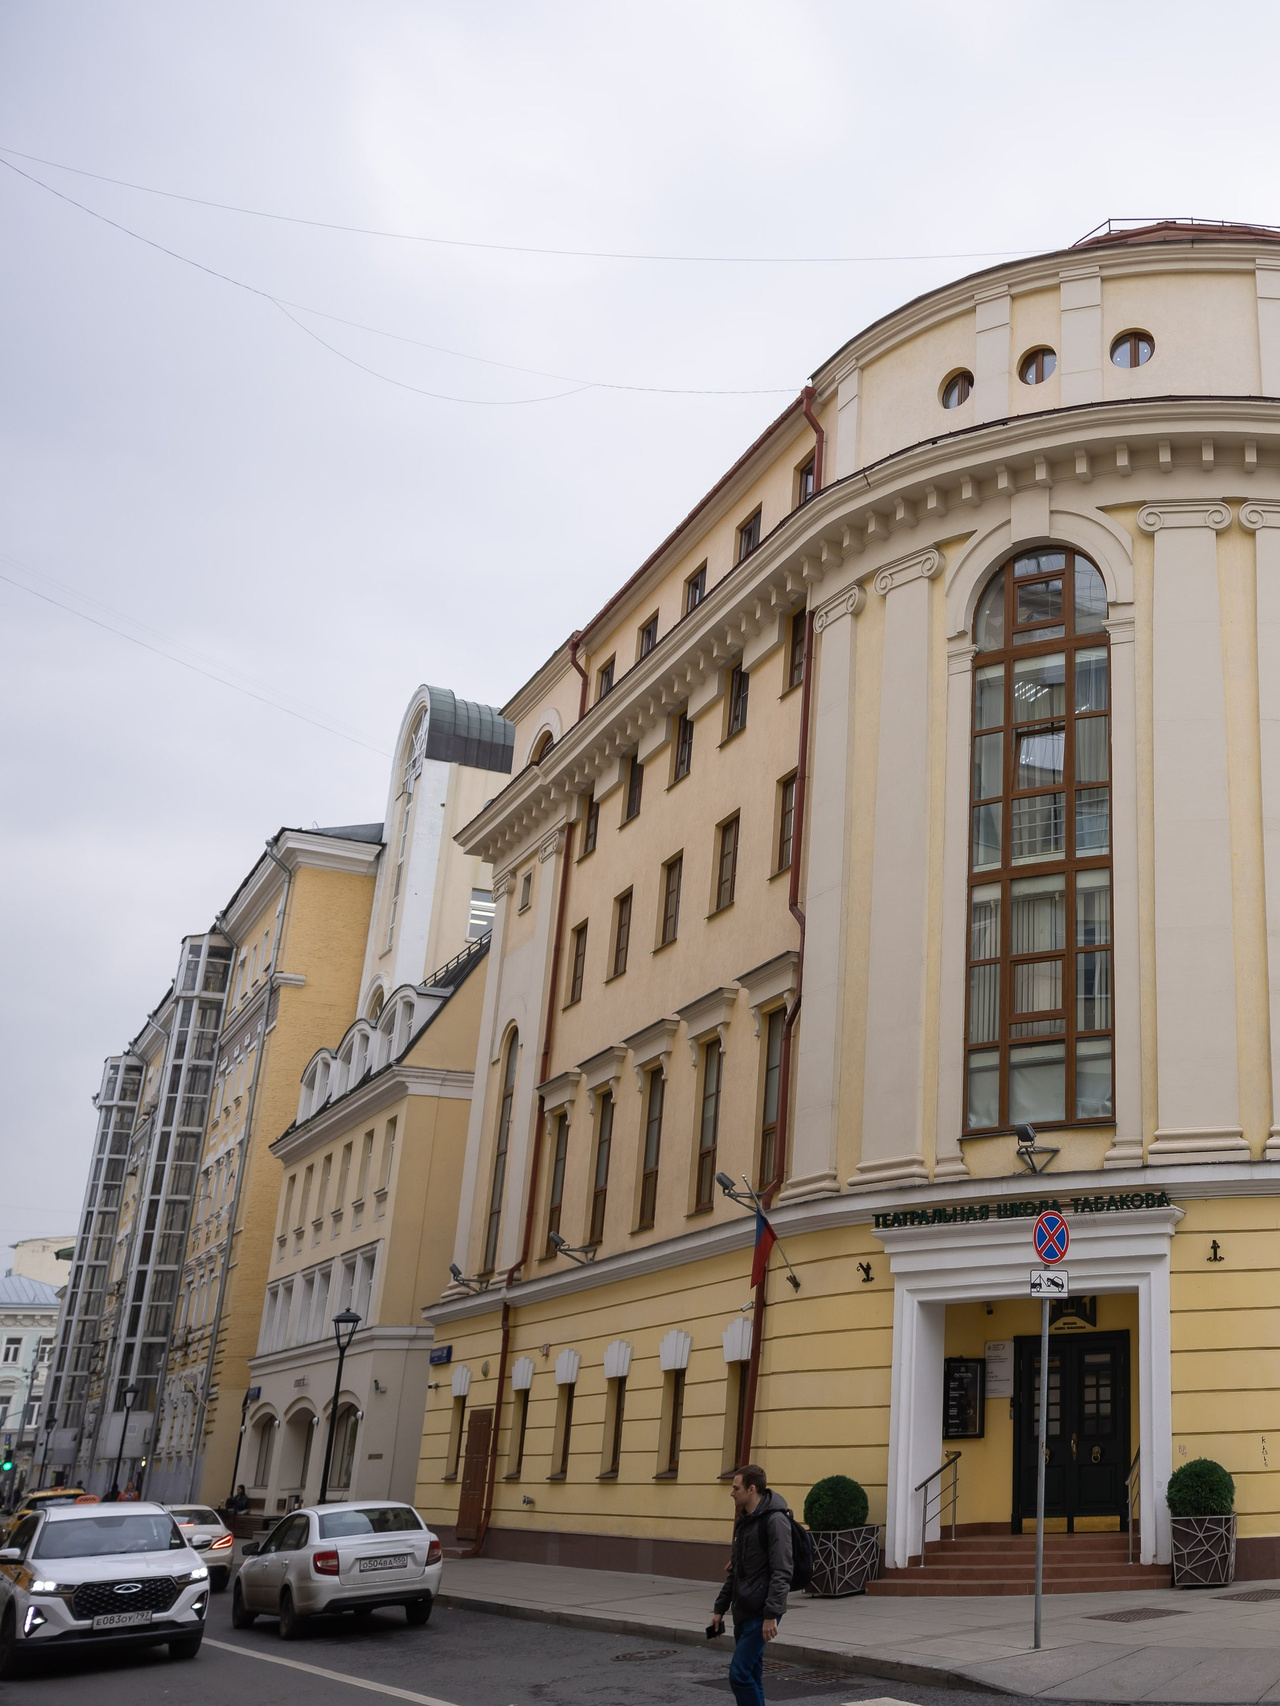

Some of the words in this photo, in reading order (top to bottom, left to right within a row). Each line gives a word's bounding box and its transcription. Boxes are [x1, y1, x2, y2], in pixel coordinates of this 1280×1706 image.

[872, 1205, 989, 1229] ТЕАТРАЛЬНАЯ
[997, 1199, 1063, 1219] ШКОЛА
[1070, 1191, 1171, 1214] ТАБАКОВА
